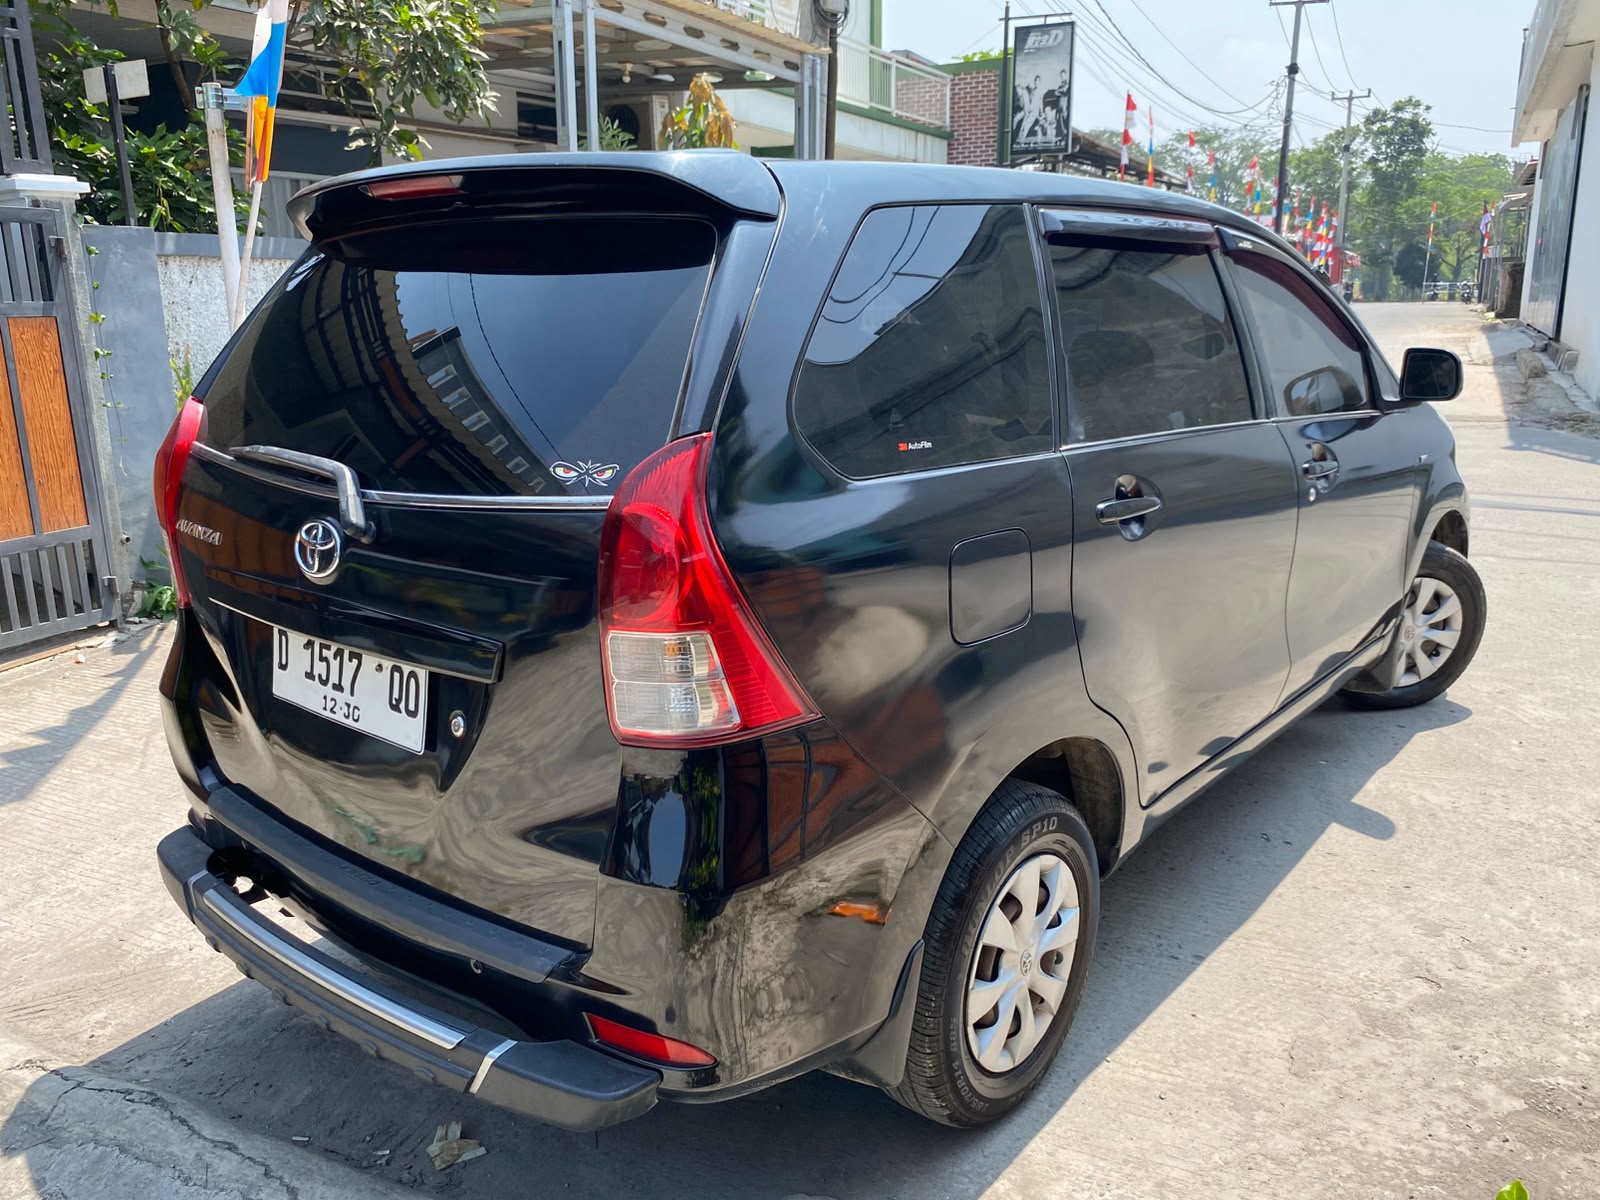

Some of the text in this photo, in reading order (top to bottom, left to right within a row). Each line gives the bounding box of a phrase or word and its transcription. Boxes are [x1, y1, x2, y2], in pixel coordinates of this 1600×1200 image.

[175, 520, 222, 545] AVANZA
[277, 629, 289, 671] D
[303, 638, 363, 697] 1517
[1020, 815, 1058, 848] SP10
